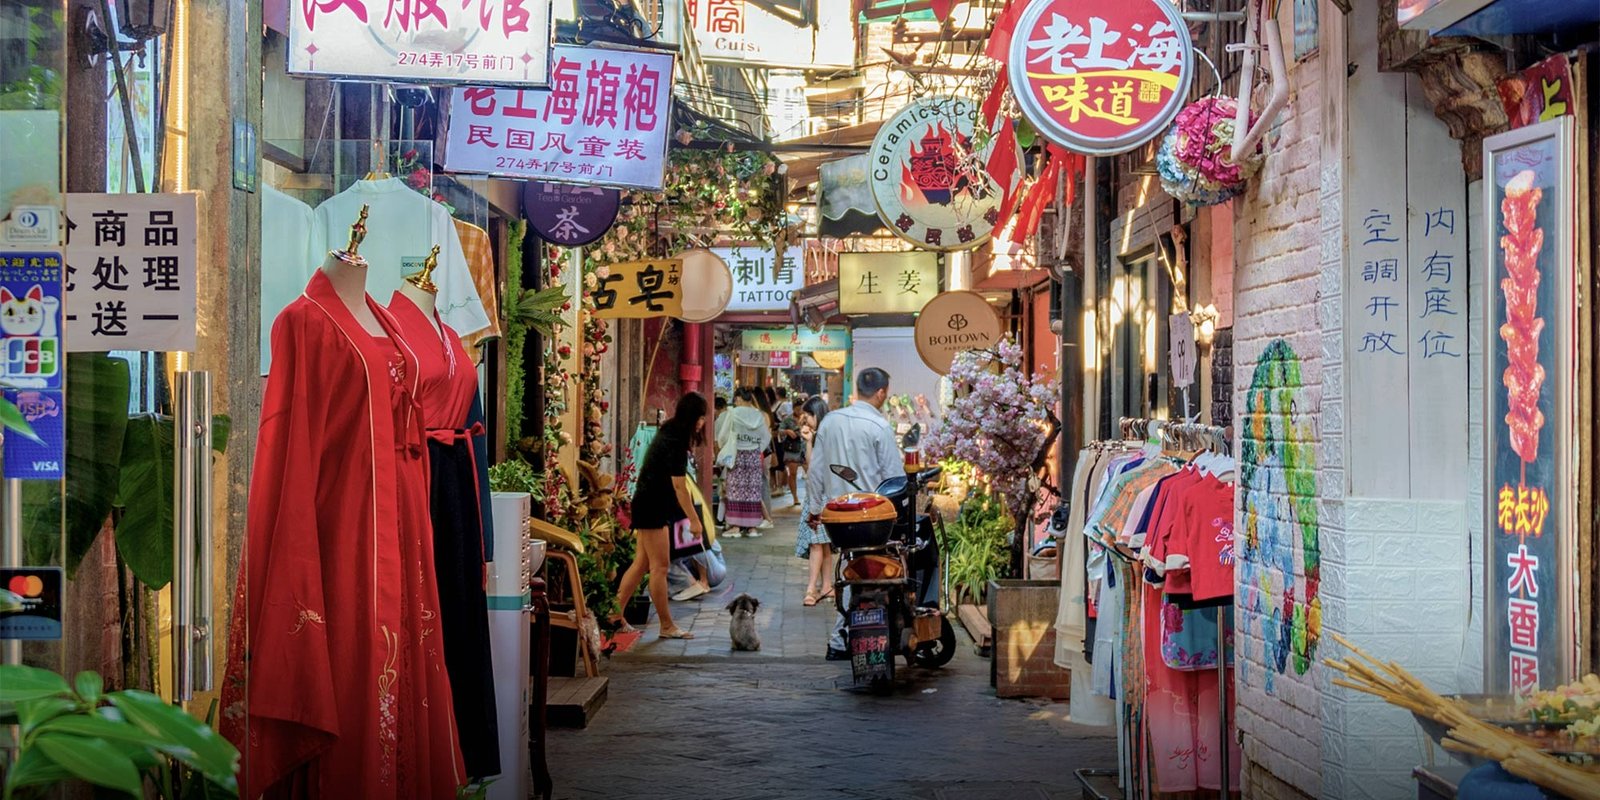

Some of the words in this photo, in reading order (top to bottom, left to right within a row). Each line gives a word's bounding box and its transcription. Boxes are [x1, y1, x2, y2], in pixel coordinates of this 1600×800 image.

[1027, 12, 1182, 74] 老上海
[398, 52, 514, 71] 274弄17号前门
[1041, 78, 1140, 126] 味道
[466, 124, 648, 161] 民国风童装
[874, 104, 941, 182] Ceramics
[496, 156, 613, 178] 274弄17号前门
[548, 205, 590, 240] 茶
[857, 270, 921, 296] 生姜
[1418, 206, 1461, 359] 内有座位
[9, 350, 54, 364] JCB
[929, 332, 990, 346] BOITOWN
[32, 461, 60, 472] VISA
[1498, 485, 1549, 537] 老长沙
[1508, 546, 1540, 697] 大香肠
